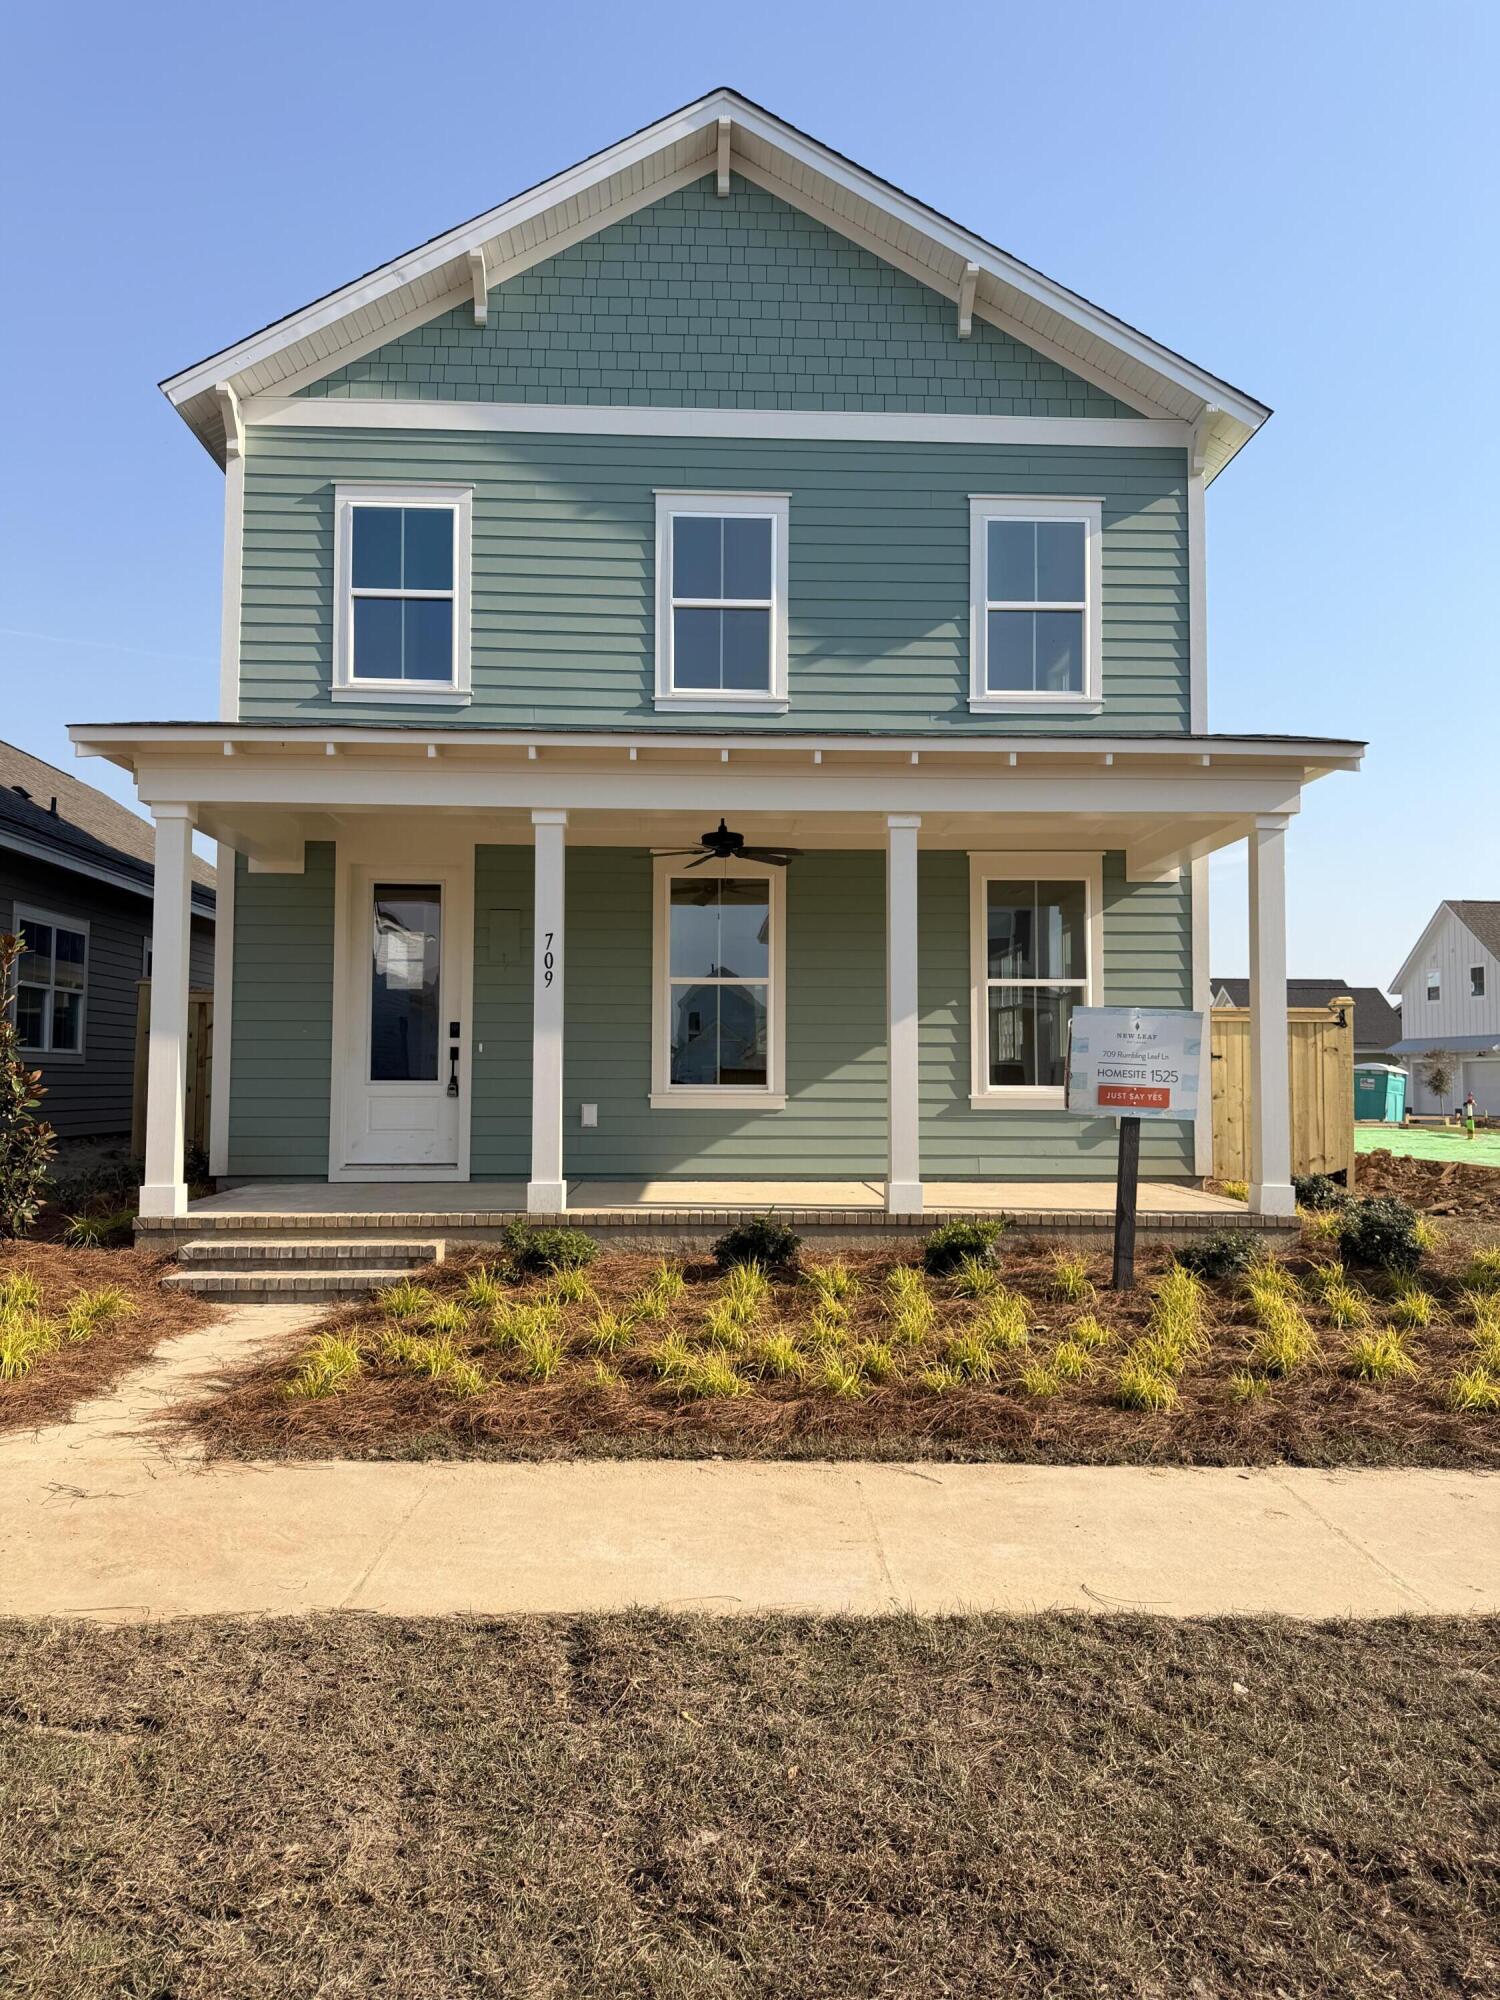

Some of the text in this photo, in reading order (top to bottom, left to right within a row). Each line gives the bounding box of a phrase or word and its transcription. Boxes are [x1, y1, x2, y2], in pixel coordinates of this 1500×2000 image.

[544, 933, 553, 988] 709
[1103, 1050, 1116, 1058] 709
[1147, 1051, 1160, 1060] Leaf
[1097, 1069, 1179, 1083] HOMESITE 1525
[1147, 1093, 1162, 1101] YES
